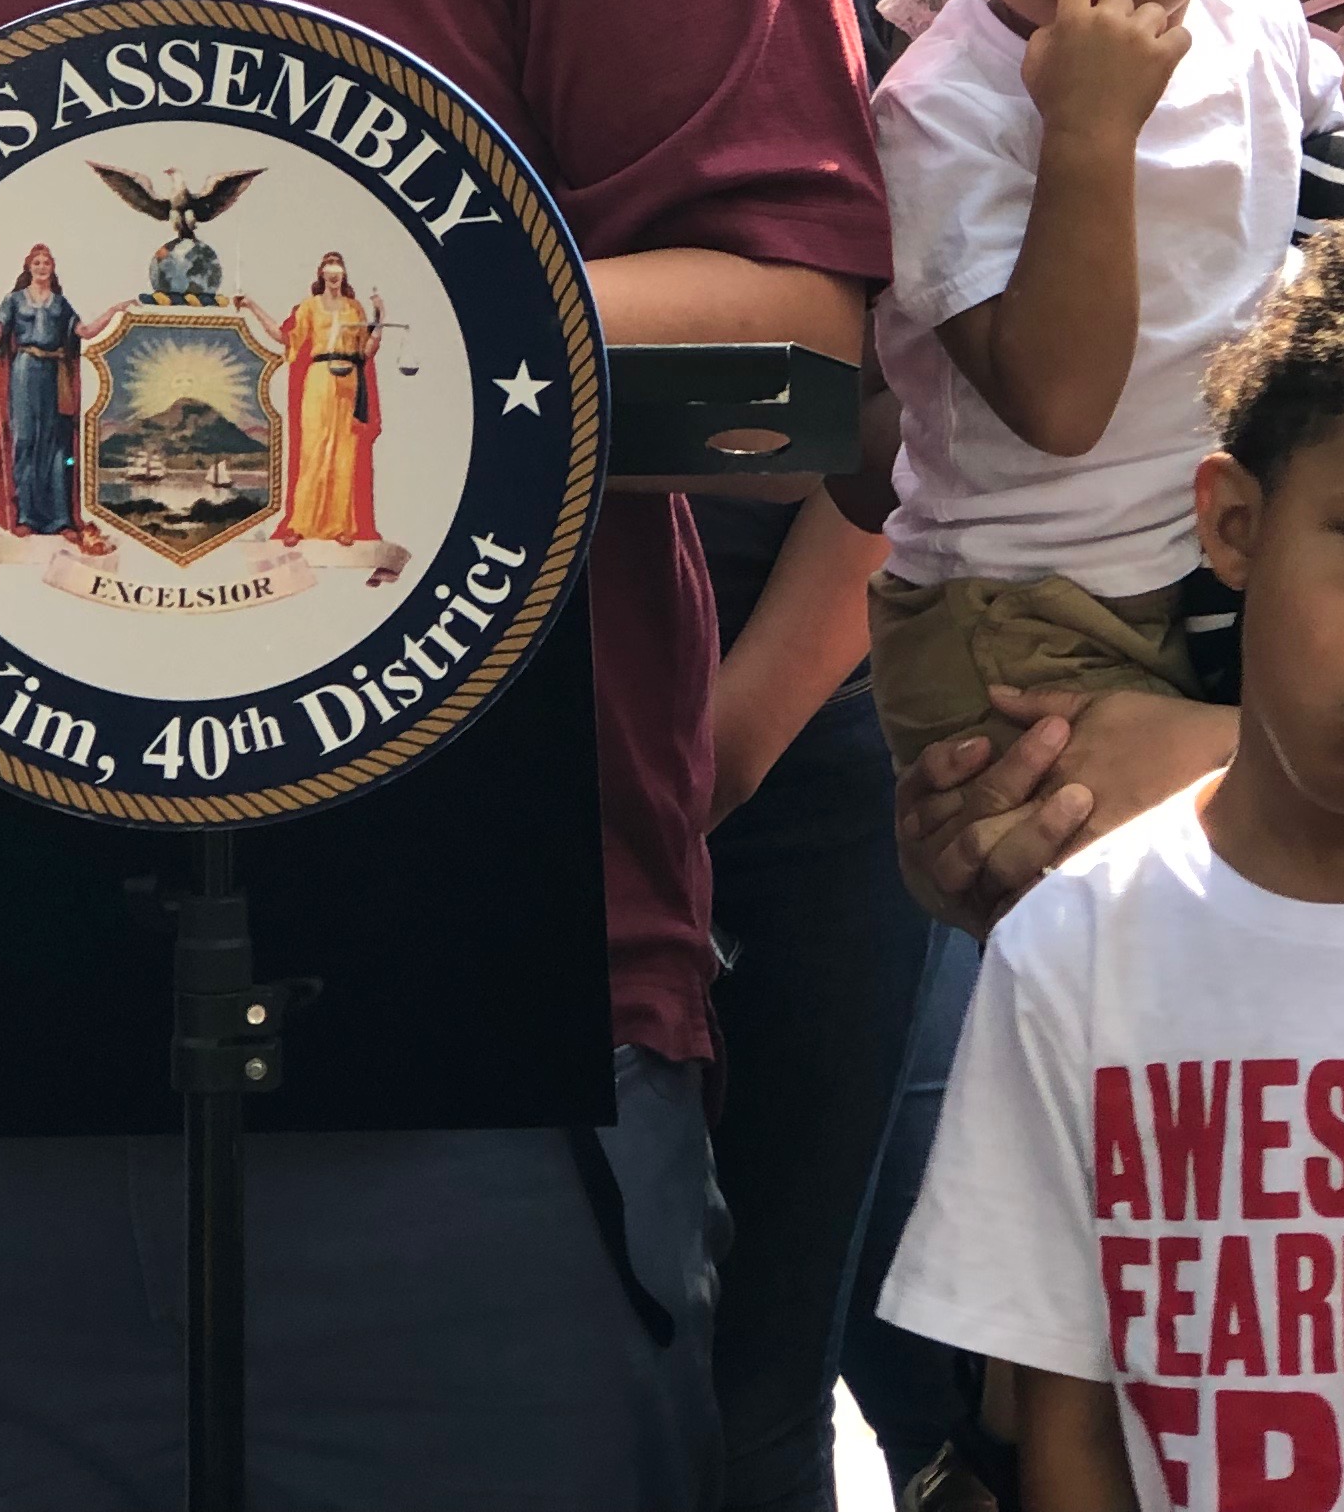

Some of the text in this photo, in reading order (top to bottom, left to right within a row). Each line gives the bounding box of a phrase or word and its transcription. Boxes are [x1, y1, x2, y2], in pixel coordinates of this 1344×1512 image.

[52, 39, 502, 245] ASSEMBLY
[89, 575, 274, 609] EXCELSIOR
[142, 707, 284, 781] 40th
[294, 530, 528, 757] District
